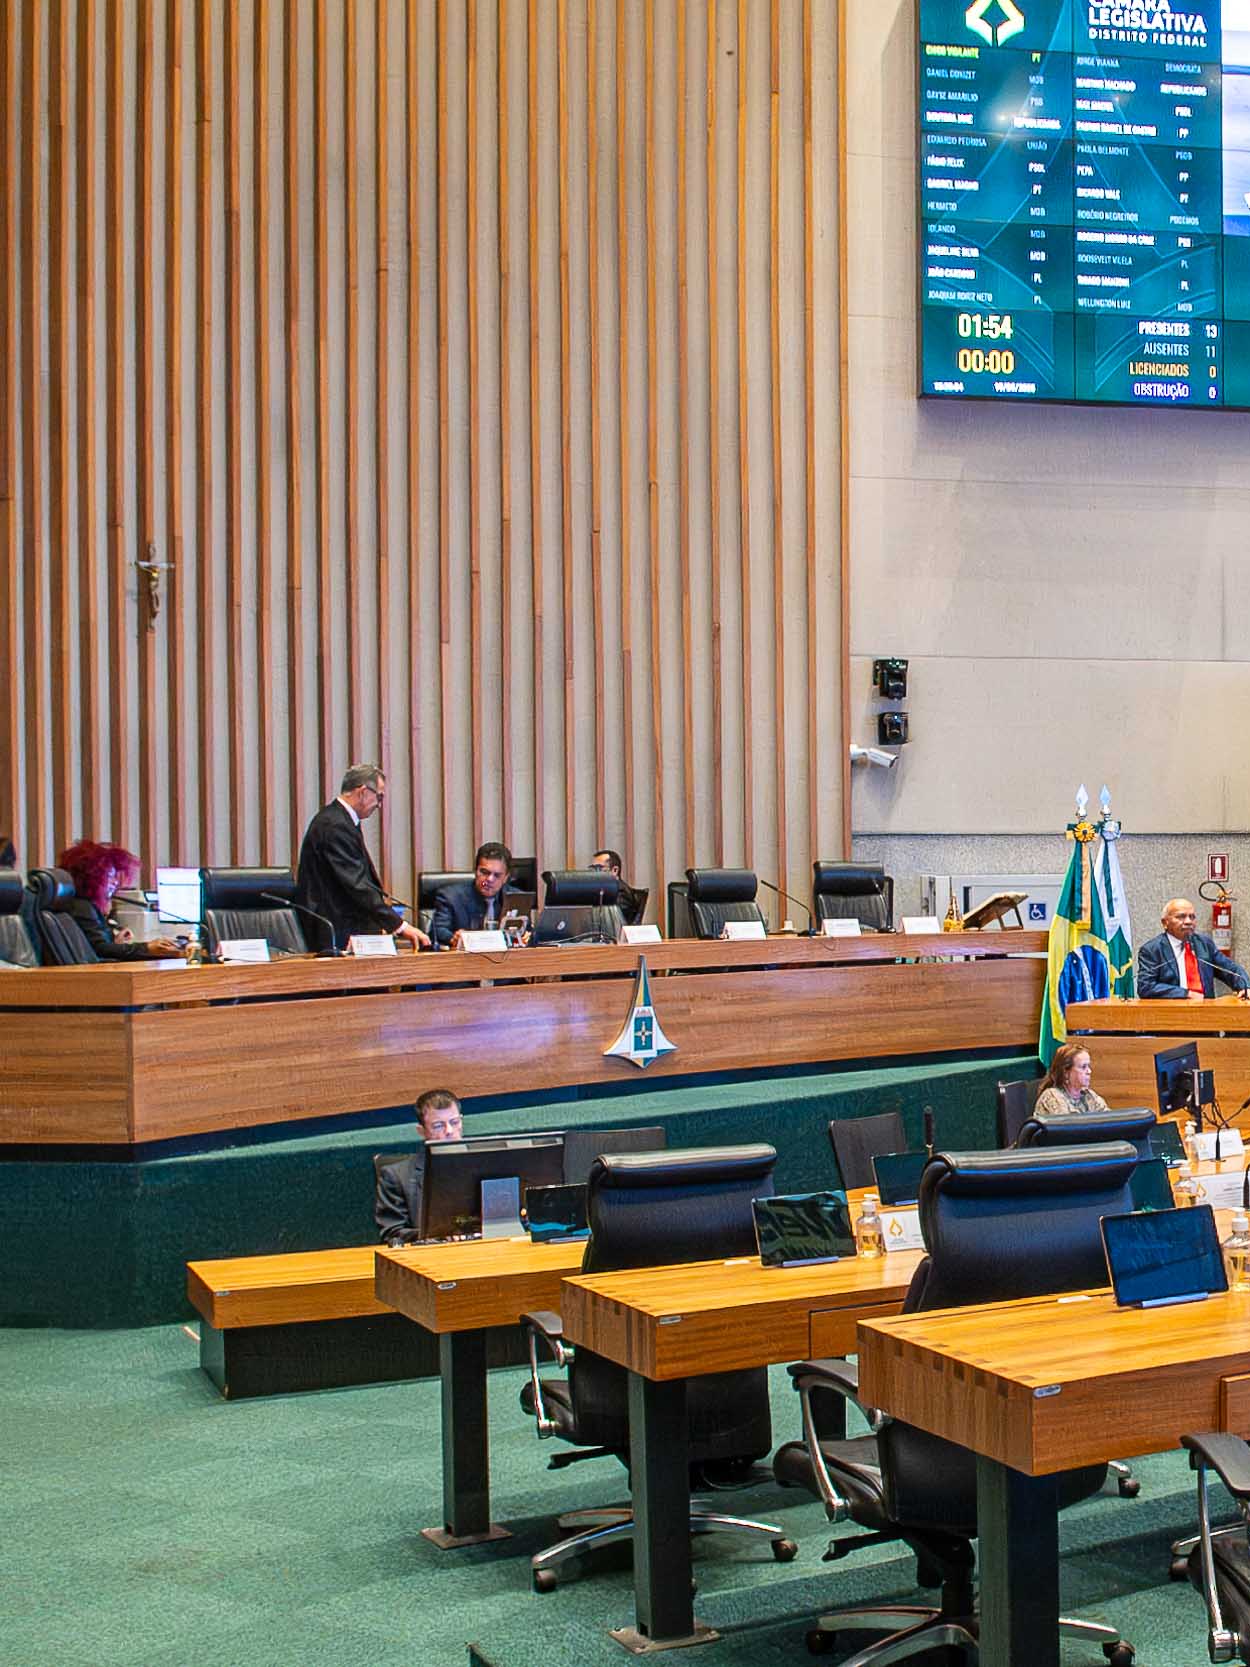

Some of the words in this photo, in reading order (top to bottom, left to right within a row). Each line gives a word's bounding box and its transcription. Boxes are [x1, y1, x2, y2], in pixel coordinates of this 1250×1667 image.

[1088, 6, 1207, 34] LEGISLATIVA
[1088, 27, 1147, 43] DISTRITO
[1152, 32, 1207, 48] FEDERAL
[958, 313, 1013, 339] 01:54
[1138, 321, 1190, 337] PRESENTES
[1206, 324, 1218, 338] 13
[1144, 342, 1189, 356] AUSENTES
[1206, 345, 1216, 358] 11
[958, 348, 1014, 374] 00:00
[1130, 362, 1189, 377] LICENCIADOS
[1209, 366, 1217, 378] 0
[1134, 382, 1189, 400] OBSTRUÇÃO
